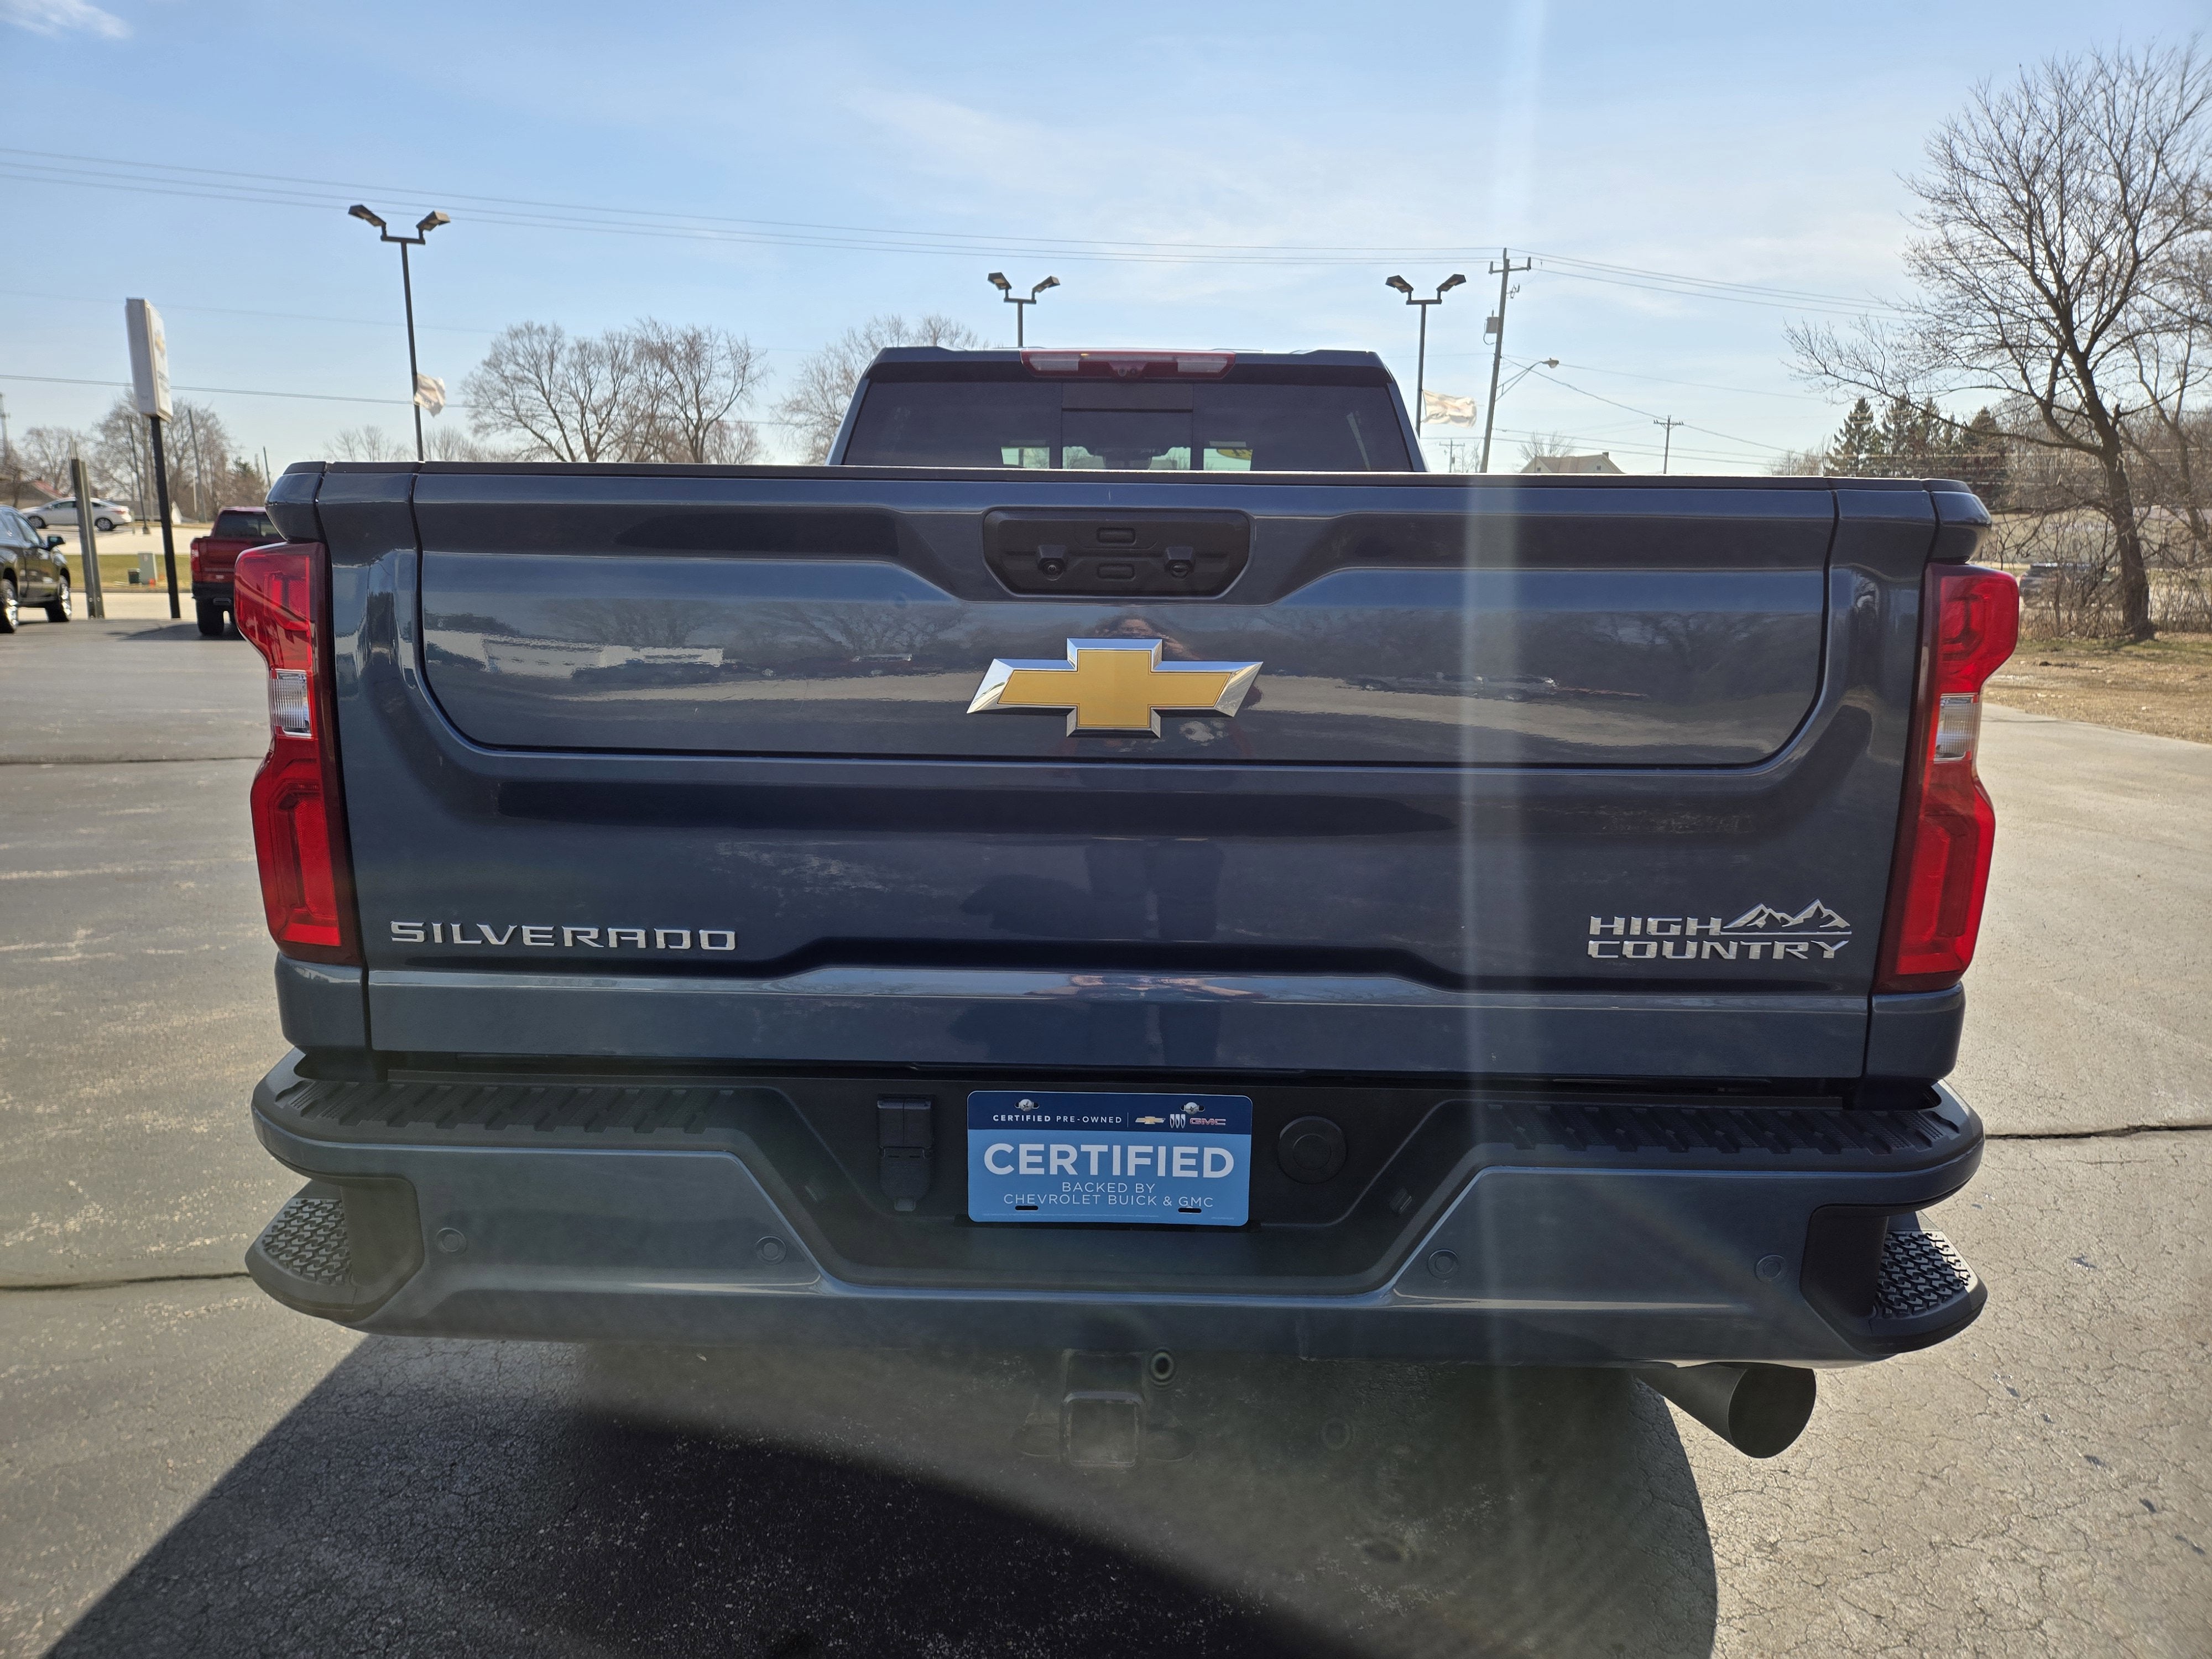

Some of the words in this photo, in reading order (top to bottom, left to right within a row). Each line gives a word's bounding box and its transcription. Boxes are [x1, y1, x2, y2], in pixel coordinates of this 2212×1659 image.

[1589, 915, 1723, 936] HIGH
[390, 921, 737, 951] SILVERADO
[1588, 940, 1849, 960] COUNTRY
[1056, 1115, 1122, 1124] PRE-OWNED
[984, 1143, 1234, 1178] CERTIFIED
[1062, 1182, 1128, 1193] BACKED
[1135, 1183, 1155, 1193] BY
[1004, 1194, 1100, 1205] CHEVROLET
[1108, 1194, 1157, 1206] BUICK
[1162, 1196, 1172, 1207] &
[1178, 1196, 1213, 1207] GMC
